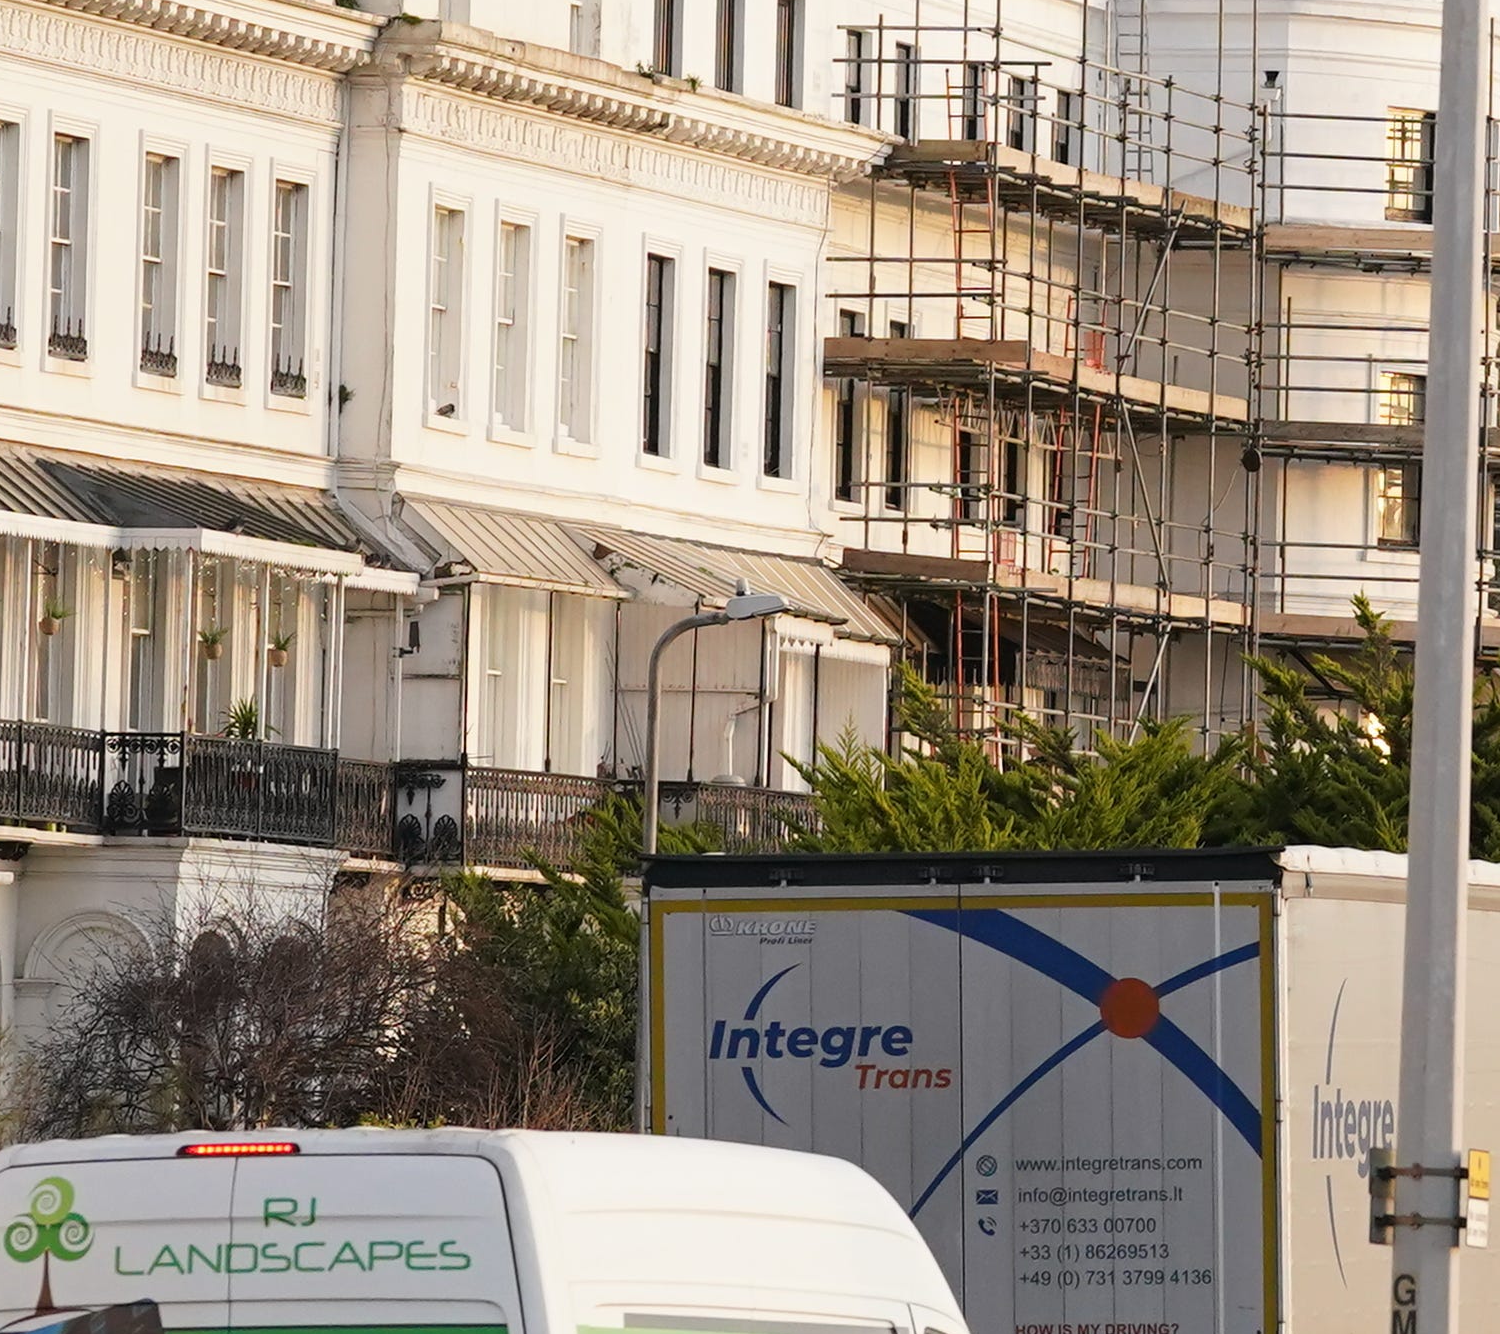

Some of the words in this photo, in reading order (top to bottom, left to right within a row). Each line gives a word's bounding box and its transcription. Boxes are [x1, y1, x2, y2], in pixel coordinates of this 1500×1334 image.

[735, 919, 817, 936] KRONE
[709, 1020, 913, 1068] Integre
[855, 1064, 952, 1090] Trans
[1313, 1085, 1394, 1178] Integre
[1016, 1156, 1202, 1175] www.integretrans.com
[1018, 1186, 1183, 1206] info@integretrans.lt
[263, 1197, 316, 1227] RJ
[1020, 1219, 1061, 1234] +370
[1067, 1218, 1098, 1234] 633
[1104, 1217, 1156, 1233] 00700
[115, 1240, 471, 1275] LANDSCAPES
[1020, 1245, 1051, 1260] +33
[1057, 1245, 1079, 1263] (1)
[1085, 1244, 1170, 1260] 86269513
[1019, 1271, 1051, 1287] +49
[1057, 1271, 1080, 1289] (0)
[1087, 1270, 1115, 1286] 731
[1122, 1270, 1165, 1286] 3799
[1170, 1269, 1213, 1285] 4136
